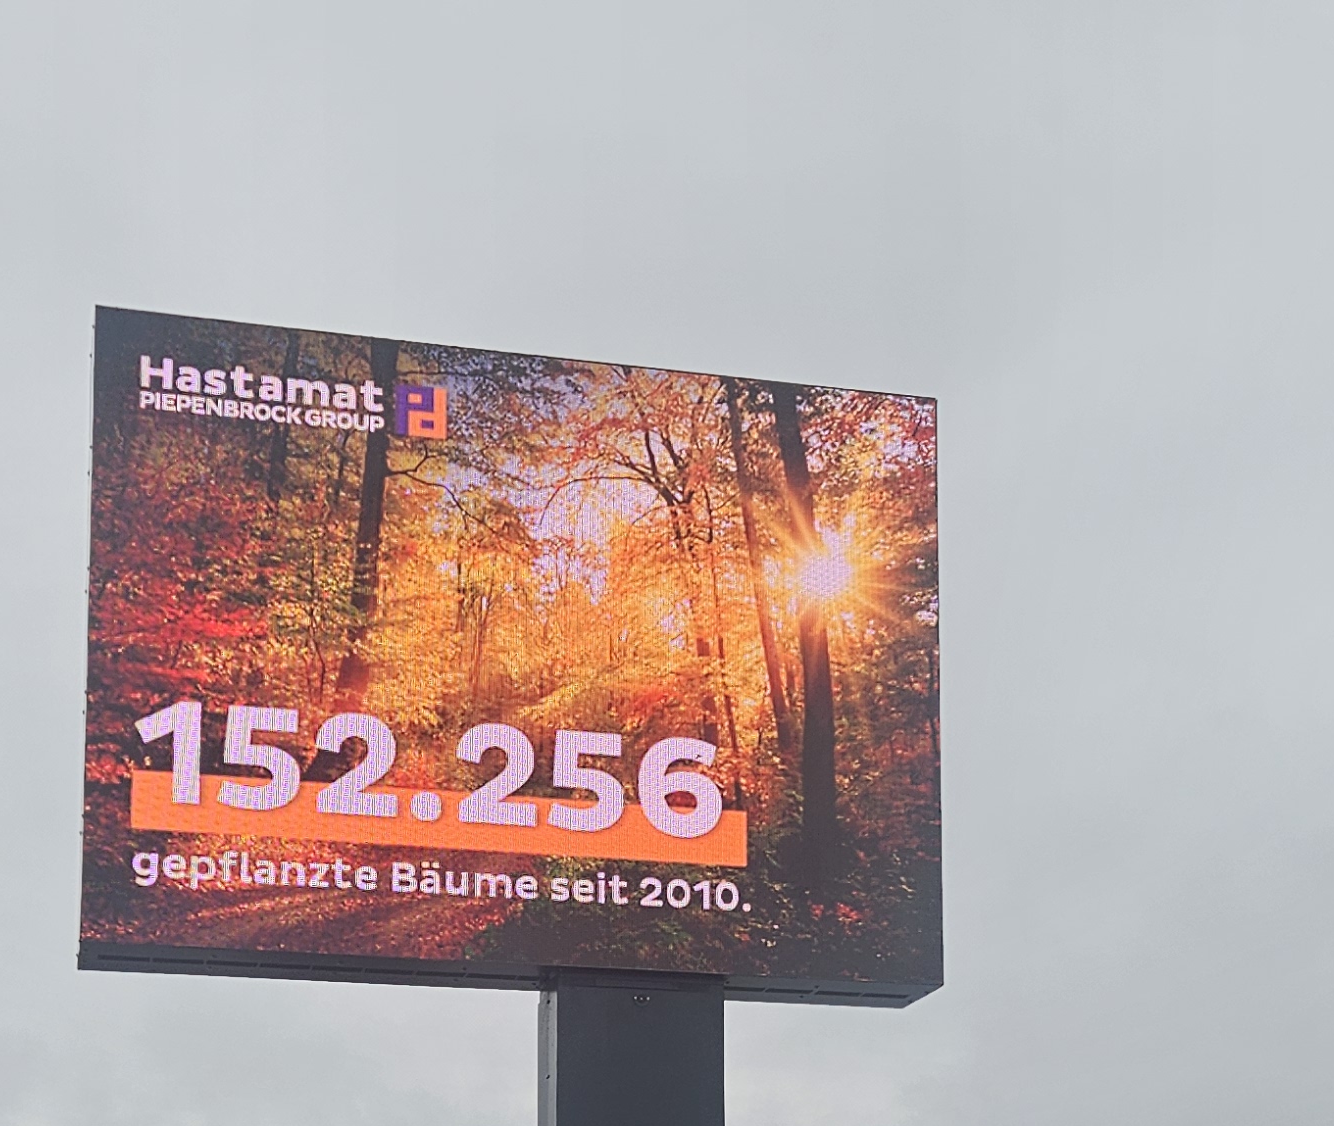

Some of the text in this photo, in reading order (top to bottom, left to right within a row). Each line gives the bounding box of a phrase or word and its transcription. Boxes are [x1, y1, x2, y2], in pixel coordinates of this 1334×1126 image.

[139, 354, 385, 413] Hastamat
[139, 390, 385, 433] PIEPENBROCK GROUP
[133, 700, 724, 840] 152.256
[132, 844, 752, 913] gepflanzte Bäume seit 2010.
